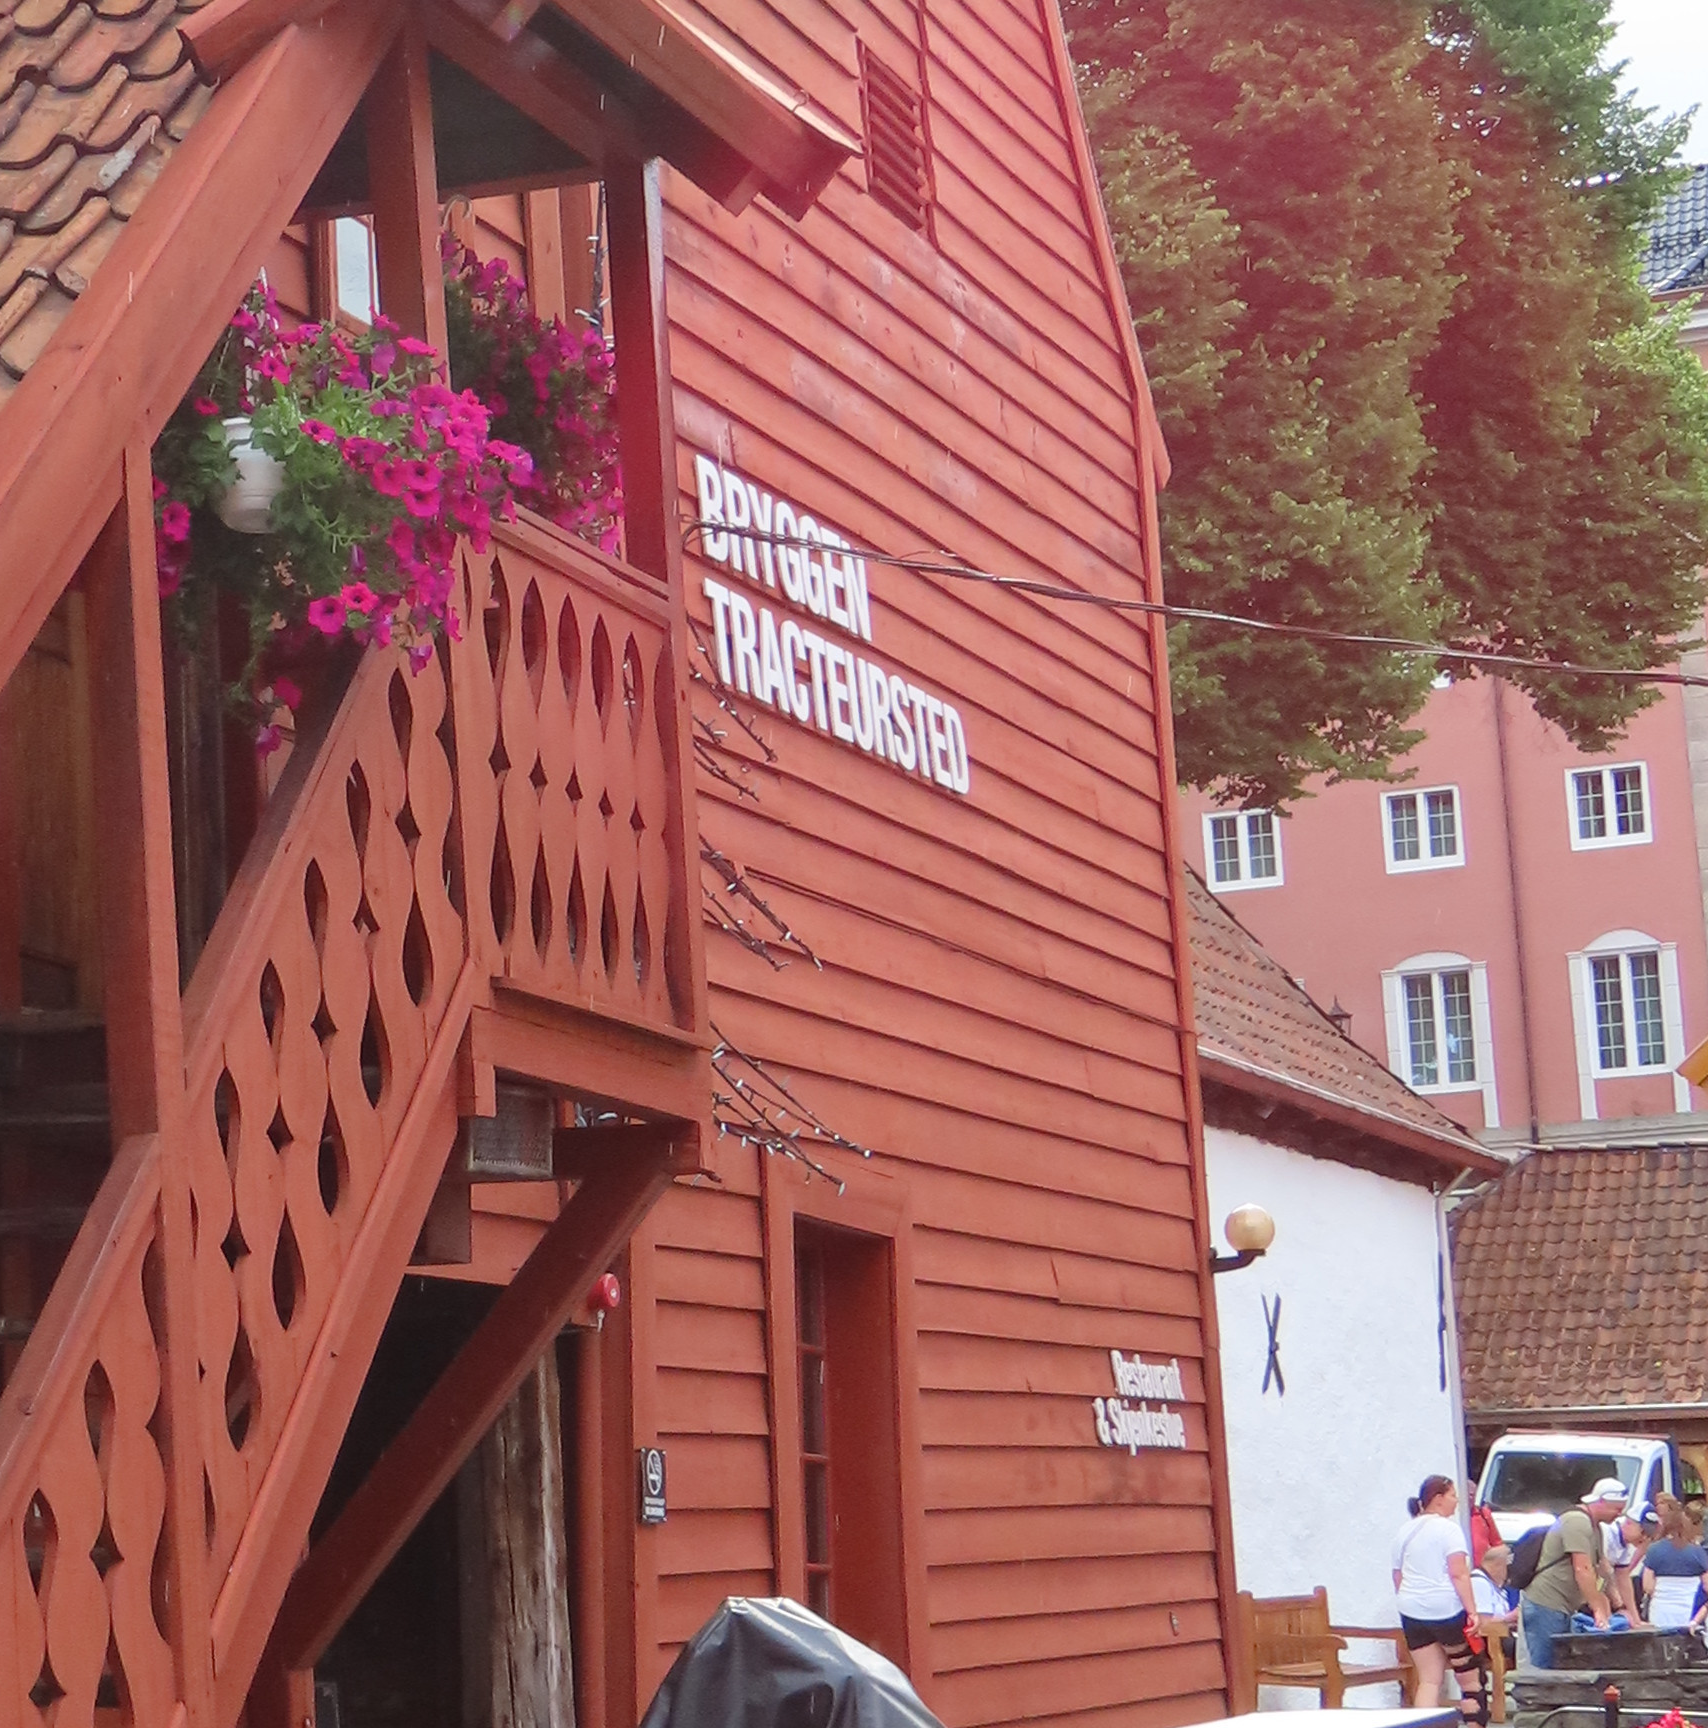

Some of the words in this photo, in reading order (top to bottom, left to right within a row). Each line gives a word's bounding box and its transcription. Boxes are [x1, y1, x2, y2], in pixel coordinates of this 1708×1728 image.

[695, 453, 873, 642] BRYGGEN
[702, 576, 970, 795] TRACTEURSTED
[1110, 1349, 1185, 1401] Restaurant
